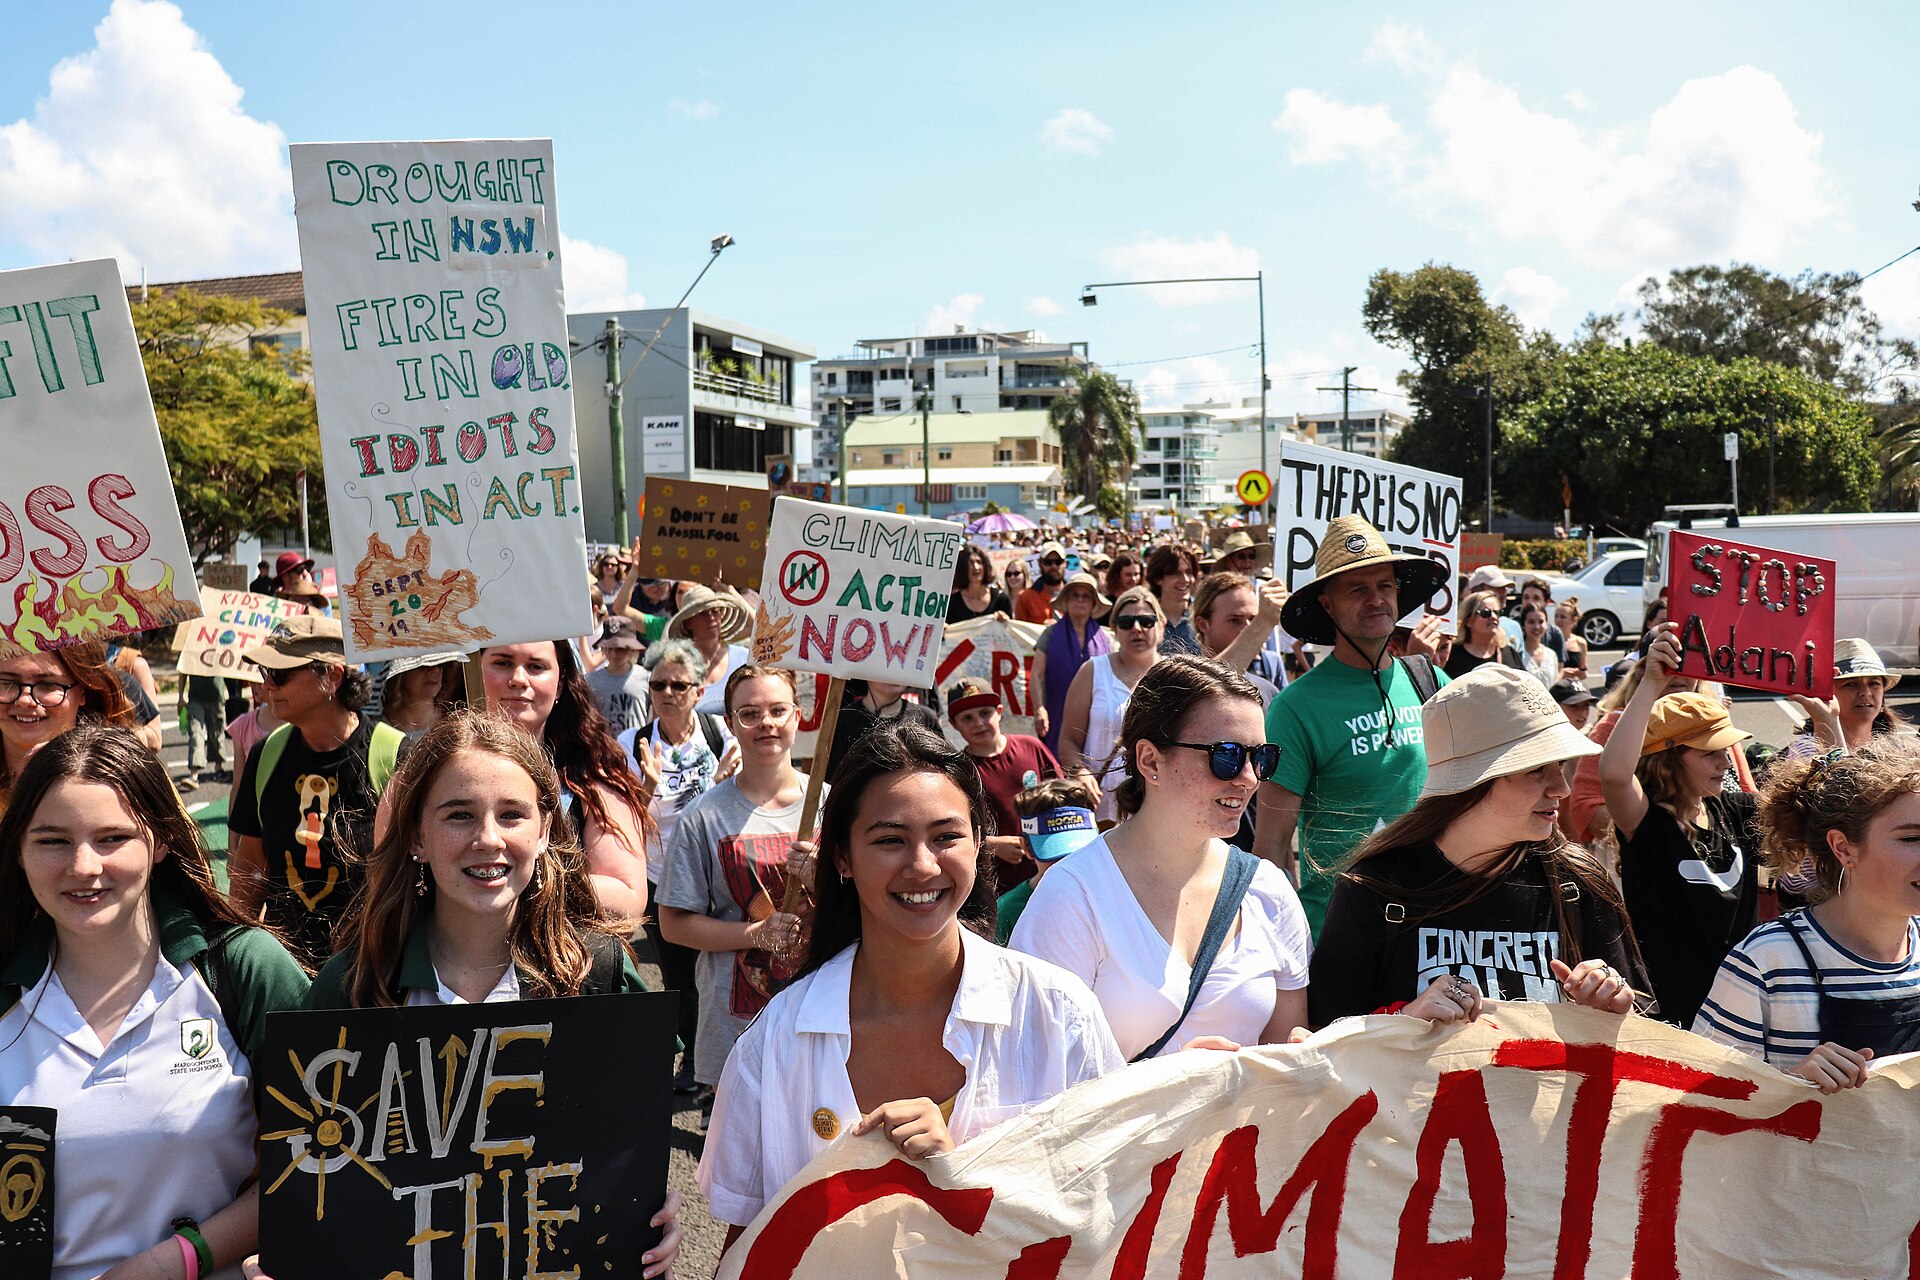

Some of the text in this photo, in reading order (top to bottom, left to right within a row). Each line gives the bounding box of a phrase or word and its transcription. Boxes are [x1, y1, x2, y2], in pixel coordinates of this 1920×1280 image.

[326, 158, 546, 207] DROUGHT
[371, 218, 441, 263] IN
[336, 287, 507, 351] FIRES
[396, 350, 480, 401] IN
[350, 406, 557, 478] IDIOTS
[646, 421, 680, 430] KANE
[385, 466, 581, 528] IN ACT.
[669, 506, 739, 524] DON'T BE
[1282, 459, 1461, 543] THERE IS NO
[657, 526, 667, 537] A
[706, 529, 741, 542] FOOL
[802, 513, 960, 570] CLIMATE
[216, 576, 232, 585] NO
[372, 569, 424, 597] SEPT
[789, 562, 949, 619] IN ACTION
[1690, 543, 1826, 617] STOP
[220, 592, 266, 609] KIDS
[265, 595, 280, 614] 4
[389, 594, 421, 616] 20
[380, 619, 410, 637] '19
[798, 614, 935, 670] NOW!
[757, 652, 776, 663] 2019
[761, 645, 773, 654] 20
[1678, 613, 1816, 690] Adani
[1345, 705, 1423, 735] YOUR VOT
[1351, 737, 1369, 756] IS
[1048, 823, 1086, 832] TRIATHLON
[203, 1062, 223, 1071] SCHOOL
[287, 1022, 553, 1174] SAVE
[392, 1157, 583, 1280] THE
